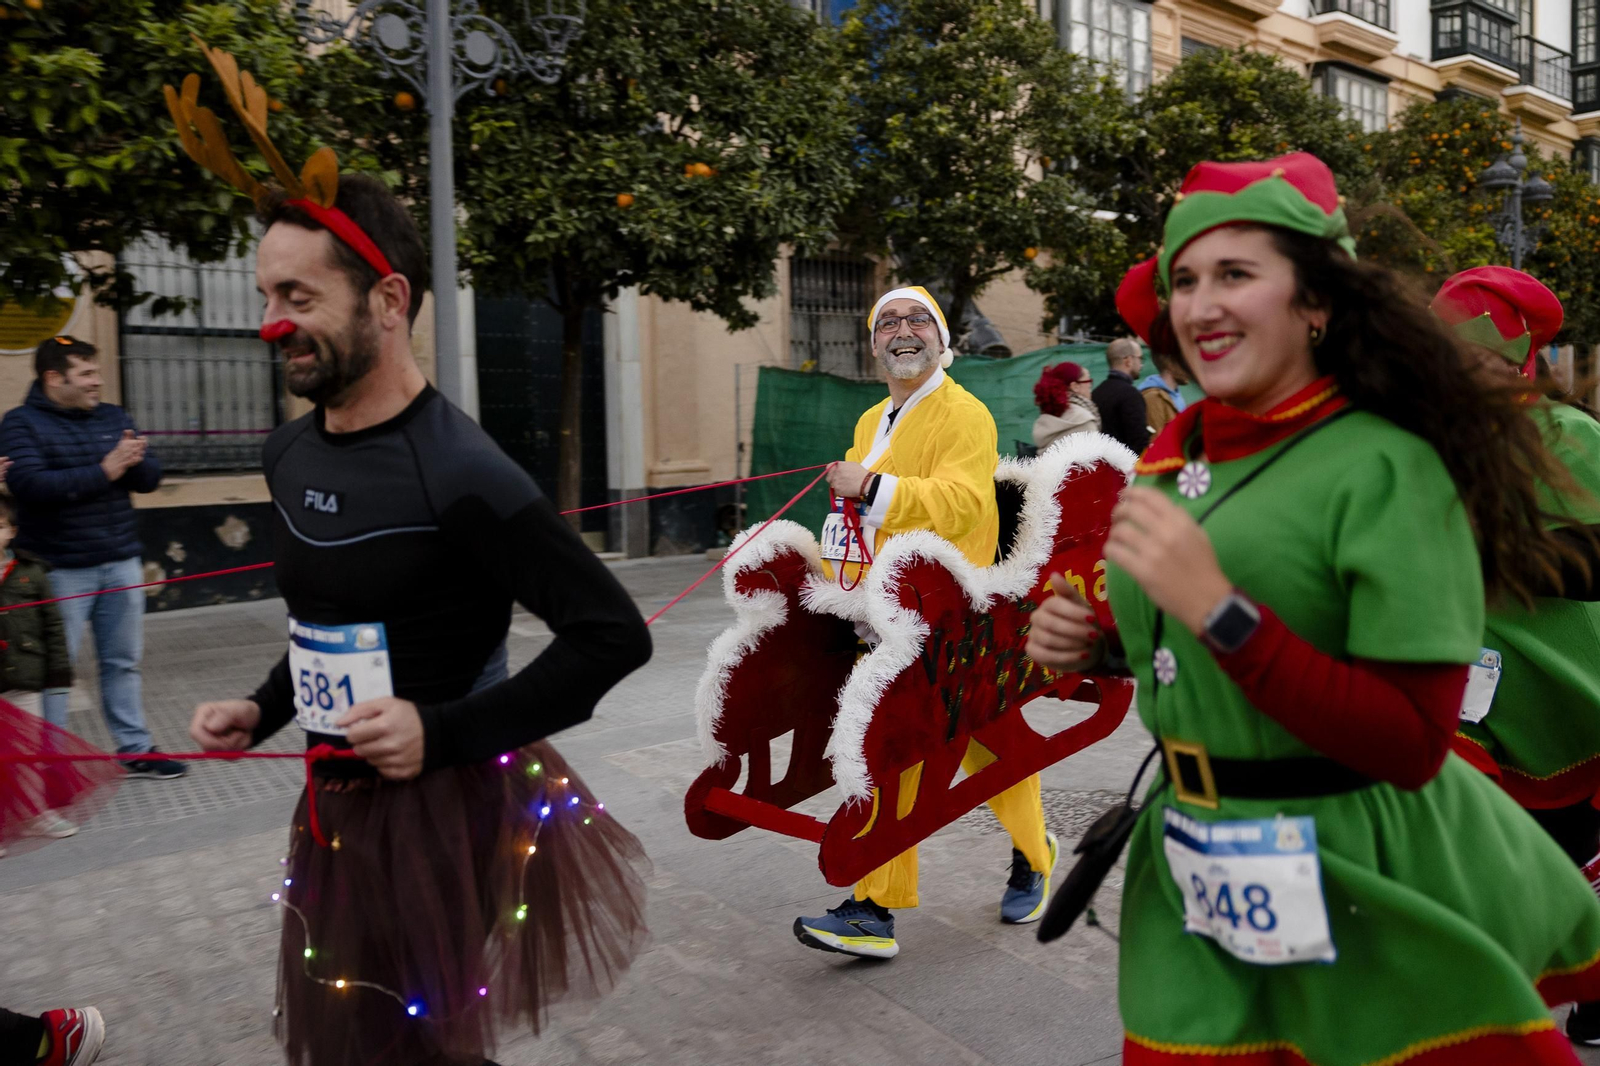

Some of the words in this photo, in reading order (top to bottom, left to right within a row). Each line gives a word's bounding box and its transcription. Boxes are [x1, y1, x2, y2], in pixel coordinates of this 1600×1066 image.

[304, 489, 338, 513] FILA
[299, 668, 354, 711] 581
[1191, 873, 1278, 932] 848
